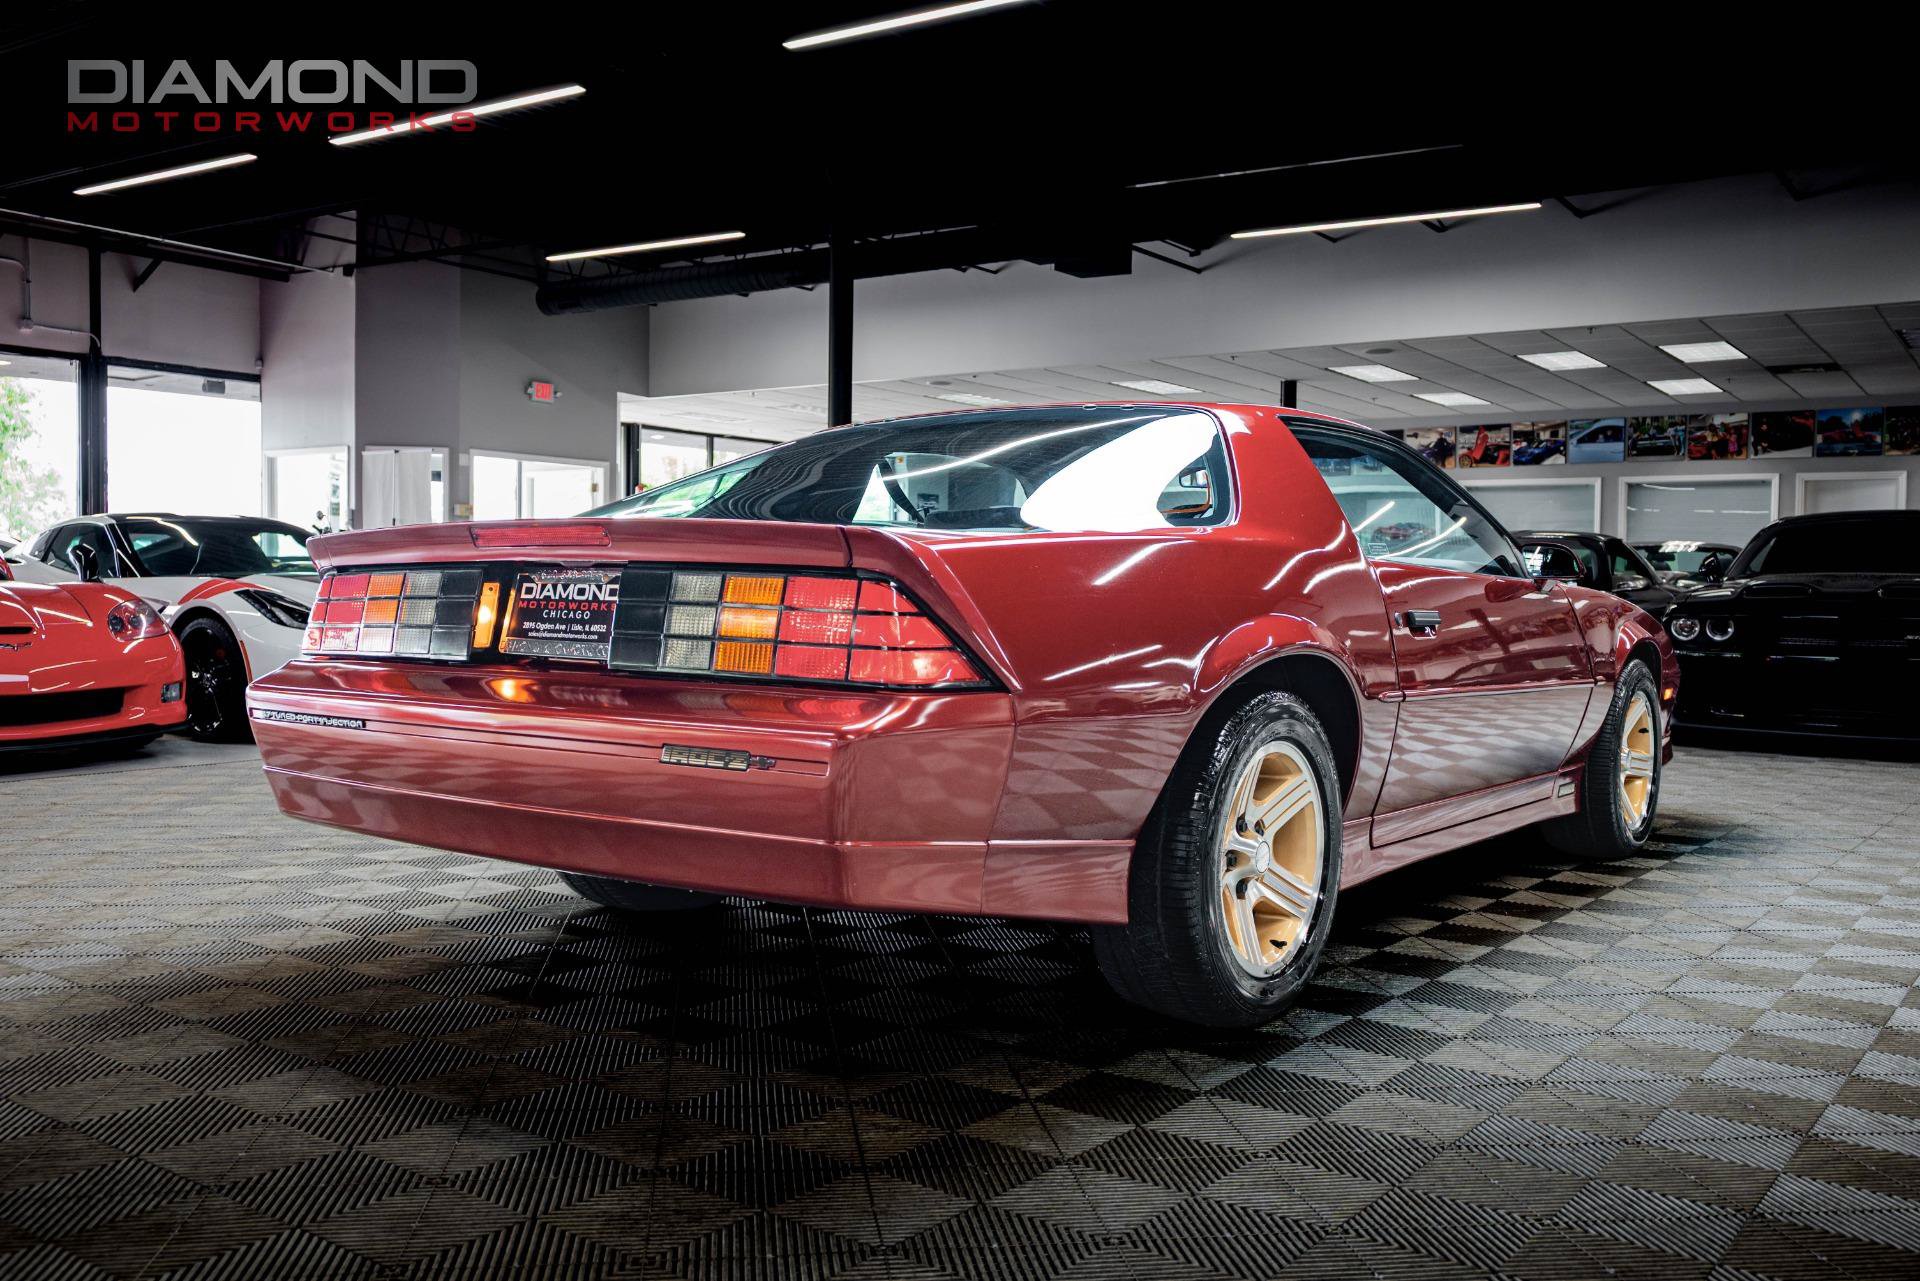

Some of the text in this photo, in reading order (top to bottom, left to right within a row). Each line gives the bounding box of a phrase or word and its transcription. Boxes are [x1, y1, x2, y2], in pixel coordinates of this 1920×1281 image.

[520, 582, 619, 600] DIAMOND
[542, 609, 591, 619] CHICAGO
[536, 622, 554, 631] Ogden
